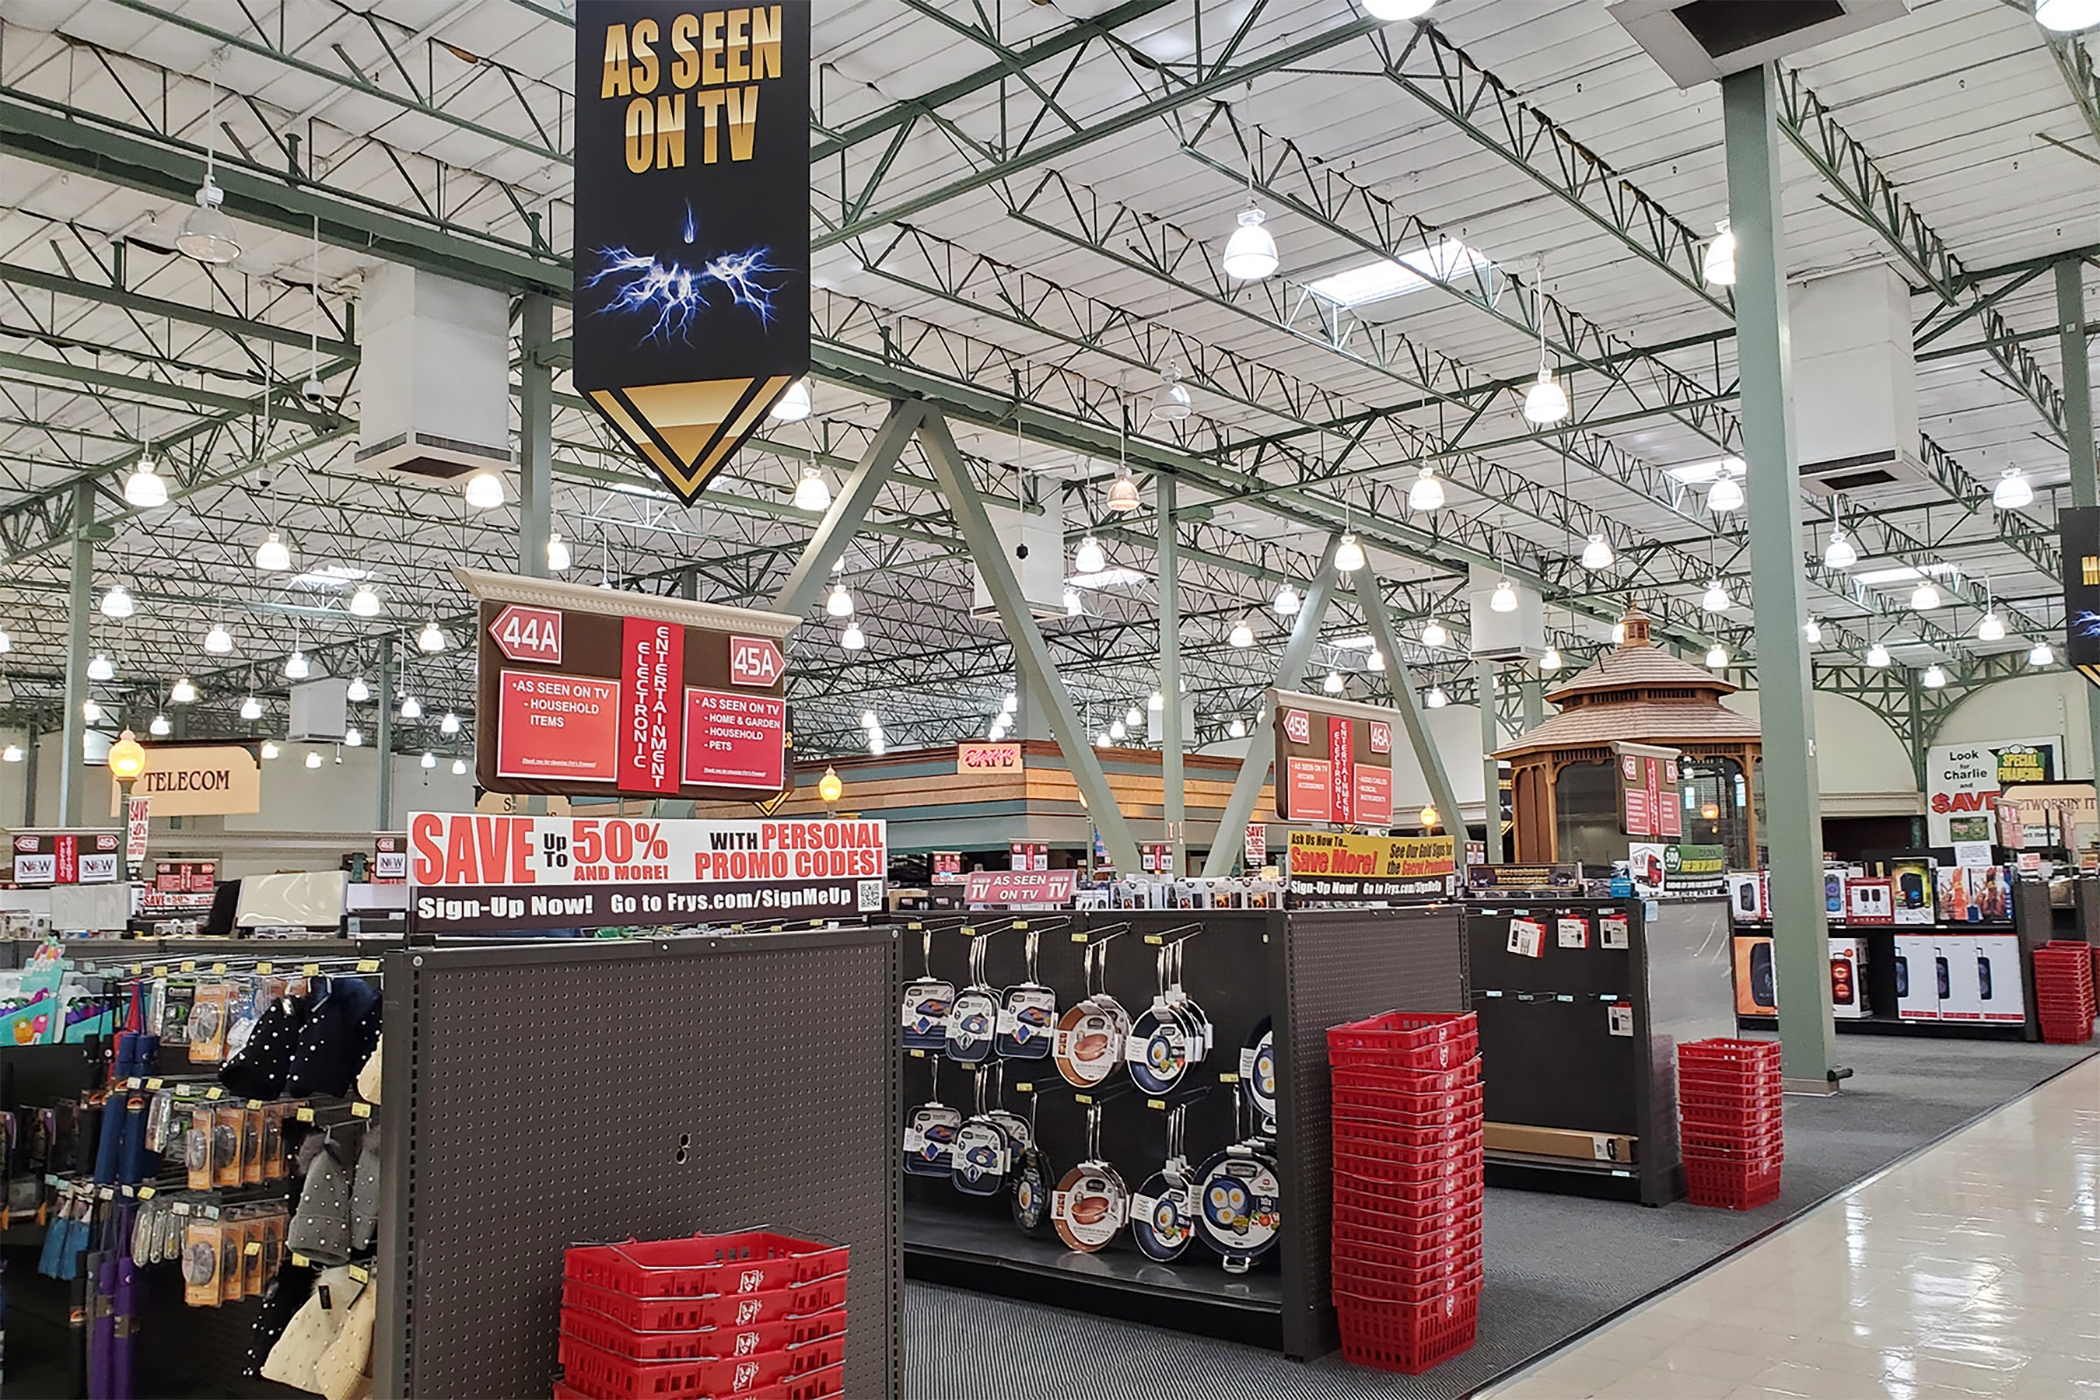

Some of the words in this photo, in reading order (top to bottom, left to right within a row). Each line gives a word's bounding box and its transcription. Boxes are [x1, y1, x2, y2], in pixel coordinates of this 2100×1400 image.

[601, 19, 660, 99] AS
[671, 5, 782, 90] SEEN
[625, 94, 686, 174] ON
[697, 85, 759, 164] TV
[503, 616, 558, 653] 44A
[734, 646, 775, 678] 45A
[516, 680, 534, 693] AS
[537, 682, 570, 696] SEEN
[573, 685, 591, 698] ON
[594, 688, 609, 699] TV
[530, 698, 599, 714] HOUSEHOLD
[633, 642, 650, 768] ELECTRONIC
[651, 626, 669, 788] ENTERTAINMENT
[702, 697, 717, 709] AS
[719, 698, 747, 712] SEEN
[749, 703, 764, 714] ON
[766, 704, 779, 715] TV
[530, 715, 565, 727] ITEMS
[709, 713, 735, 724] HOME
[737, 716, 744, 725] &
[745, 717, 780, 729] GARDEN
[1288, 716, 1308, 737] 45B
[709, 727, 763, 740] HOUSEHOLD
[1372, 727, 1389, 746] 46A
[709, 740, 732, 751] PETS
[1949, 750, 1979, 761] Look
[144, 770, 230, 792] TELECOM
[1944, 769, 1987, 780] Charlie
[2083, 797, 2096, 810] IT
[573, 820, 668, 864] 50%
[710, 832, 758, 850] WITH
[762, 823, 883, 850] PERSONAL
[1291, 833, 1304, 845] Ask
[1306, 834, 1314, 845] Us
[1316, 835, 1332, 846] How
[412, 813, 536, 885] SAVE
[544, 833, 567, 850] Up
[1389, 843, 1405, 859] See
[544, 851, 568, 868] To
[695, 850, 788, 880] PROMO
[795, 849, 883, 878] CODES!
[1290, 846, 1329, 873] Save
[1331, 848, 1378, 875] More!
[1386, 860, 1401, 875] the
[574, 866, 609, 881] AND
[614, 865, 669, 881] MORE!
[993, 875, 1010, 886] AS
[1013, 874, 1046, 885] SEEN
[971, 883, 990, 899] TV
[999, 890, 1018, 900] ON
[1022, 890, 1040, 899] TV
[1048, 882, 1068, 898] TV
[1290, 880, 1331, 895] Sign-Up
[1332, 879, 1358, 895] Now!
[1363, 882, 1374, 895] Go
[1375, 883, 1383, 894] to
[418, 896, 524, 920] Sign-Up
[531, 895, 593, 916] Now!
[611, 894, 636, 914] Go
[642, 894, 662, 912] to
[667, 887, 851, 912] Frys.com/SignMeUp
